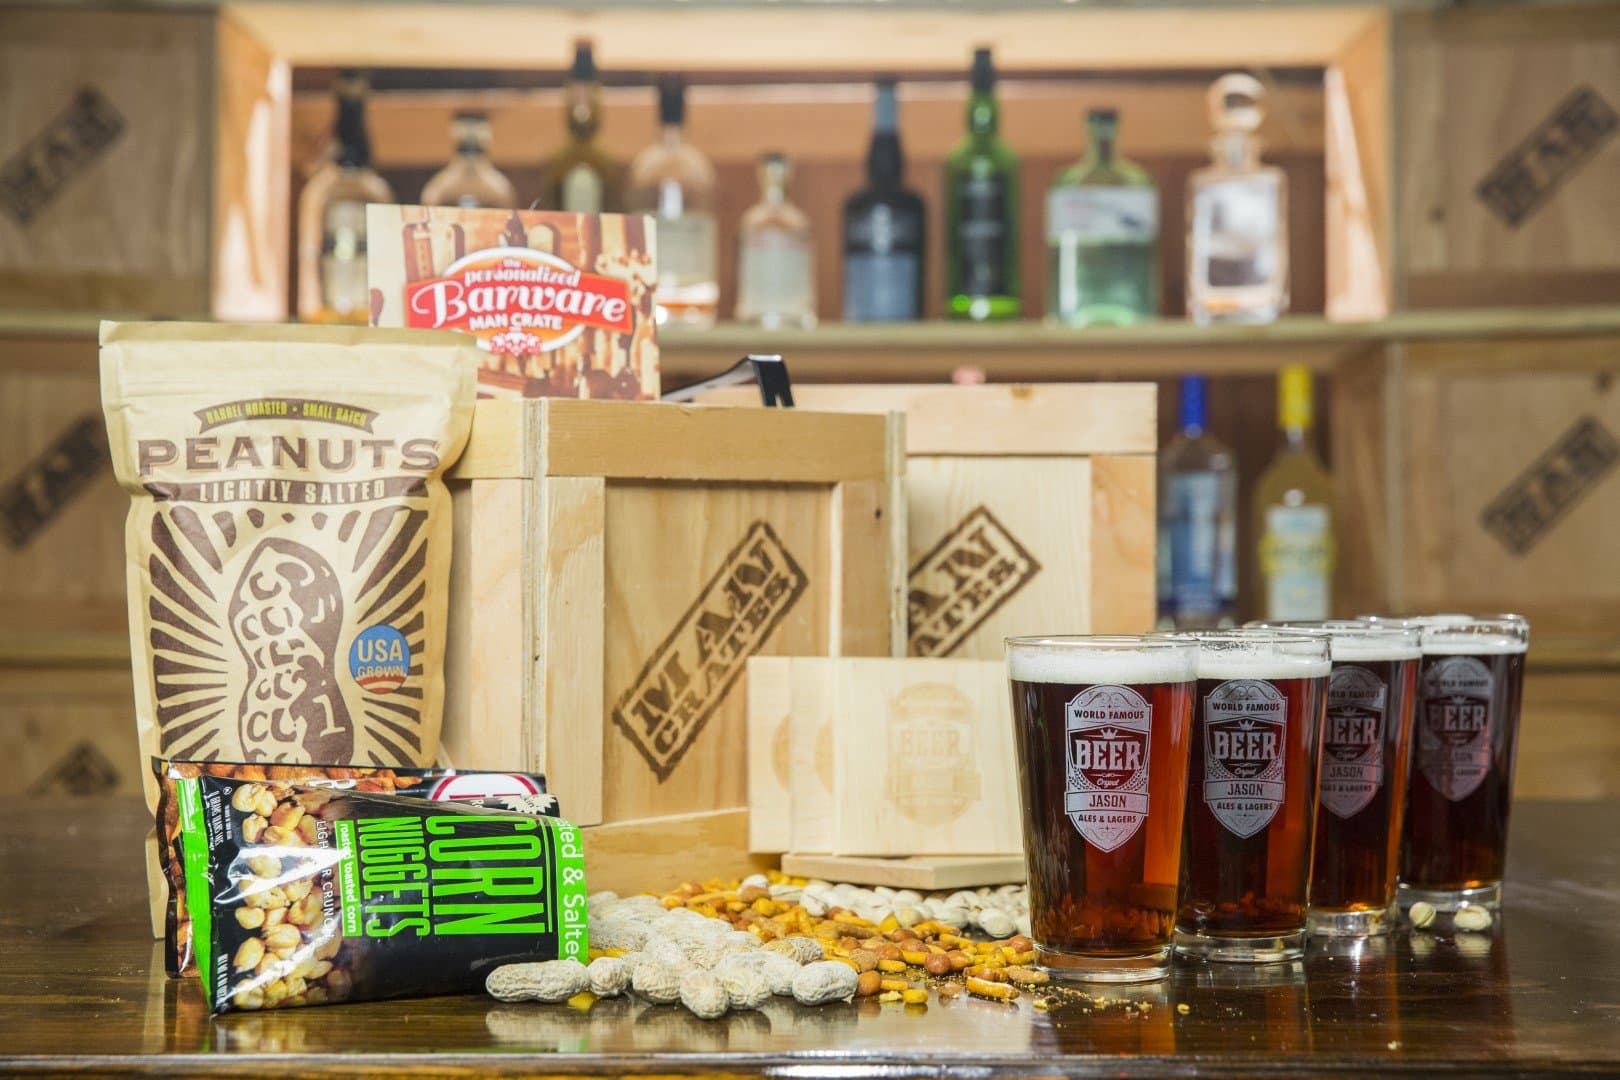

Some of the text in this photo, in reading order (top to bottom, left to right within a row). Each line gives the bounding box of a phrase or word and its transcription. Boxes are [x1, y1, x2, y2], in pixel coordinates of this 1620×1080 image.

[465, 264, 582, 288] personalized
[411, 280, 627, 329] Barware
[469, 313, 563, 331] MAN CRATE
[245, 401, 288, 416] ROASTED
[302, 402, 333, 420] SMALL
[335, 407, 368, 426] BATCH
[138, 435, 441, 477] PEANUTS
[200, 478, 386, 504] LIGHTLY SALTED
[907, 526, 998, 641] AN
[915, 558, 1017, 657] ATES
[357, 638, 404, 663] USA
[631, 539, 778, 738] MAN
[357, 664, 407, 679] GROWN
[654, 571, 791, 756] CRATES
[1074, 709, 1145, 720] WORLD FAMOUS
[1212, 702, 1280, 712] WORLD FAMOUS
[1074, 739, 1142, 771] BEER
[1213, 731, 1277, 760] BEER
[1089, 794, 1127, 808] JASON
[1228, 783, 1264, 796] JASON
[1078, 813, 1137, 824] ALES & LAGERS
[1217, 801, 1273, 811] ALES & LAGERS
[316, 821, 335, 938] LIGHR CRUNCH
[343, 862, 357, 903] toasted
[357, 816, 431, 938] NUGGETS
[426, 814, 546, 937] CORN
[563, 866, 584, 886] &
[346, 905, 358, 933] corn
